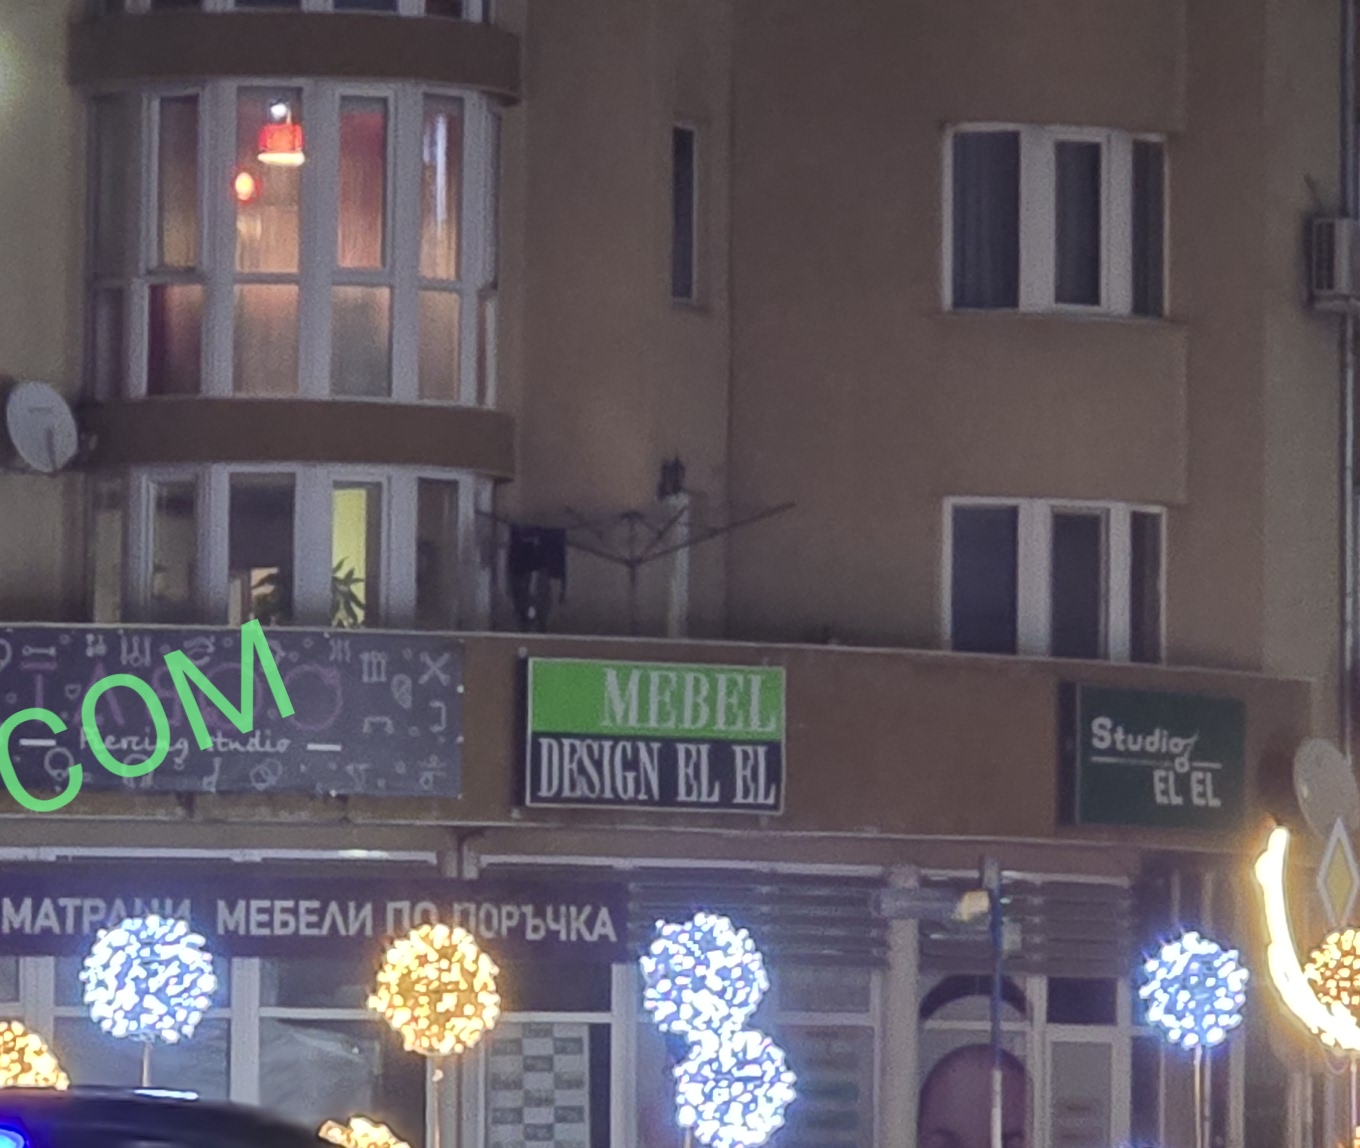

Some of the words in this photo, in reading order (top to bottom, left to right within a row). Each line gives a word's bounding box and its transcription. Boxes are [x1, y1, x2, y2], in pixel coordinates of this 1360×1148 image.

[601, 667, 776, 732] MEBEL
[1091, 716, 1186, 754] Studio
[537, 737, 661, 800] DESIGN
[676, 742, 720, 803] EL
[733, 744, 776, 805] EL
[1153, 769, 1184, 806] EL
[1191, 771, 1222, 807] EL
[216, 899, 373, 937] МЕБЕЛИ
[386, 901, 439, 935] ПО
[453, 902, 617, 942] ПОРЪЧКА
